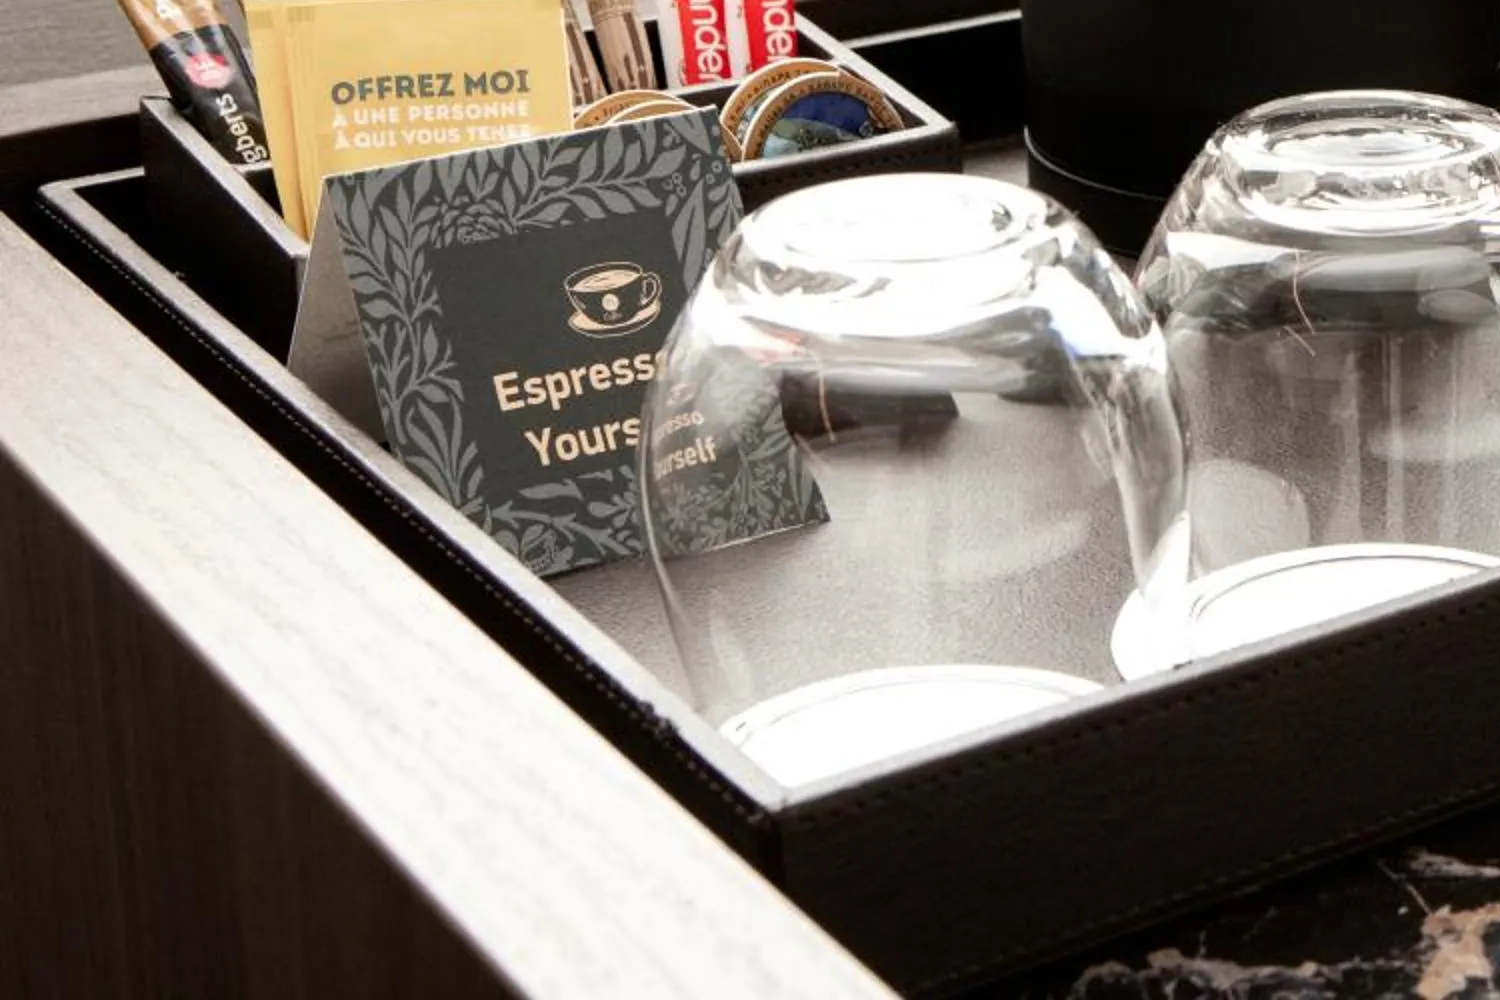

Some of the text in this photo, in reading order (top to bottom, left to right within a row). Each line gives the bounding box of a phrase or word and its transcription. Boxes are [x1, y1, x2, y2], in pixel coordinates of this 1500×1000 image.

[331, 69, 530, 105] OFFREZ MOI
[215, 92, 268, 163] gberts
[353, 105, 401, 125] UNE
[408, 100, 529, 122] PERSONNE
[353, 130, 397, 149] QUI
[402, 128, 461, 145] VOUS
[524, 417, 641, 467] Yours
